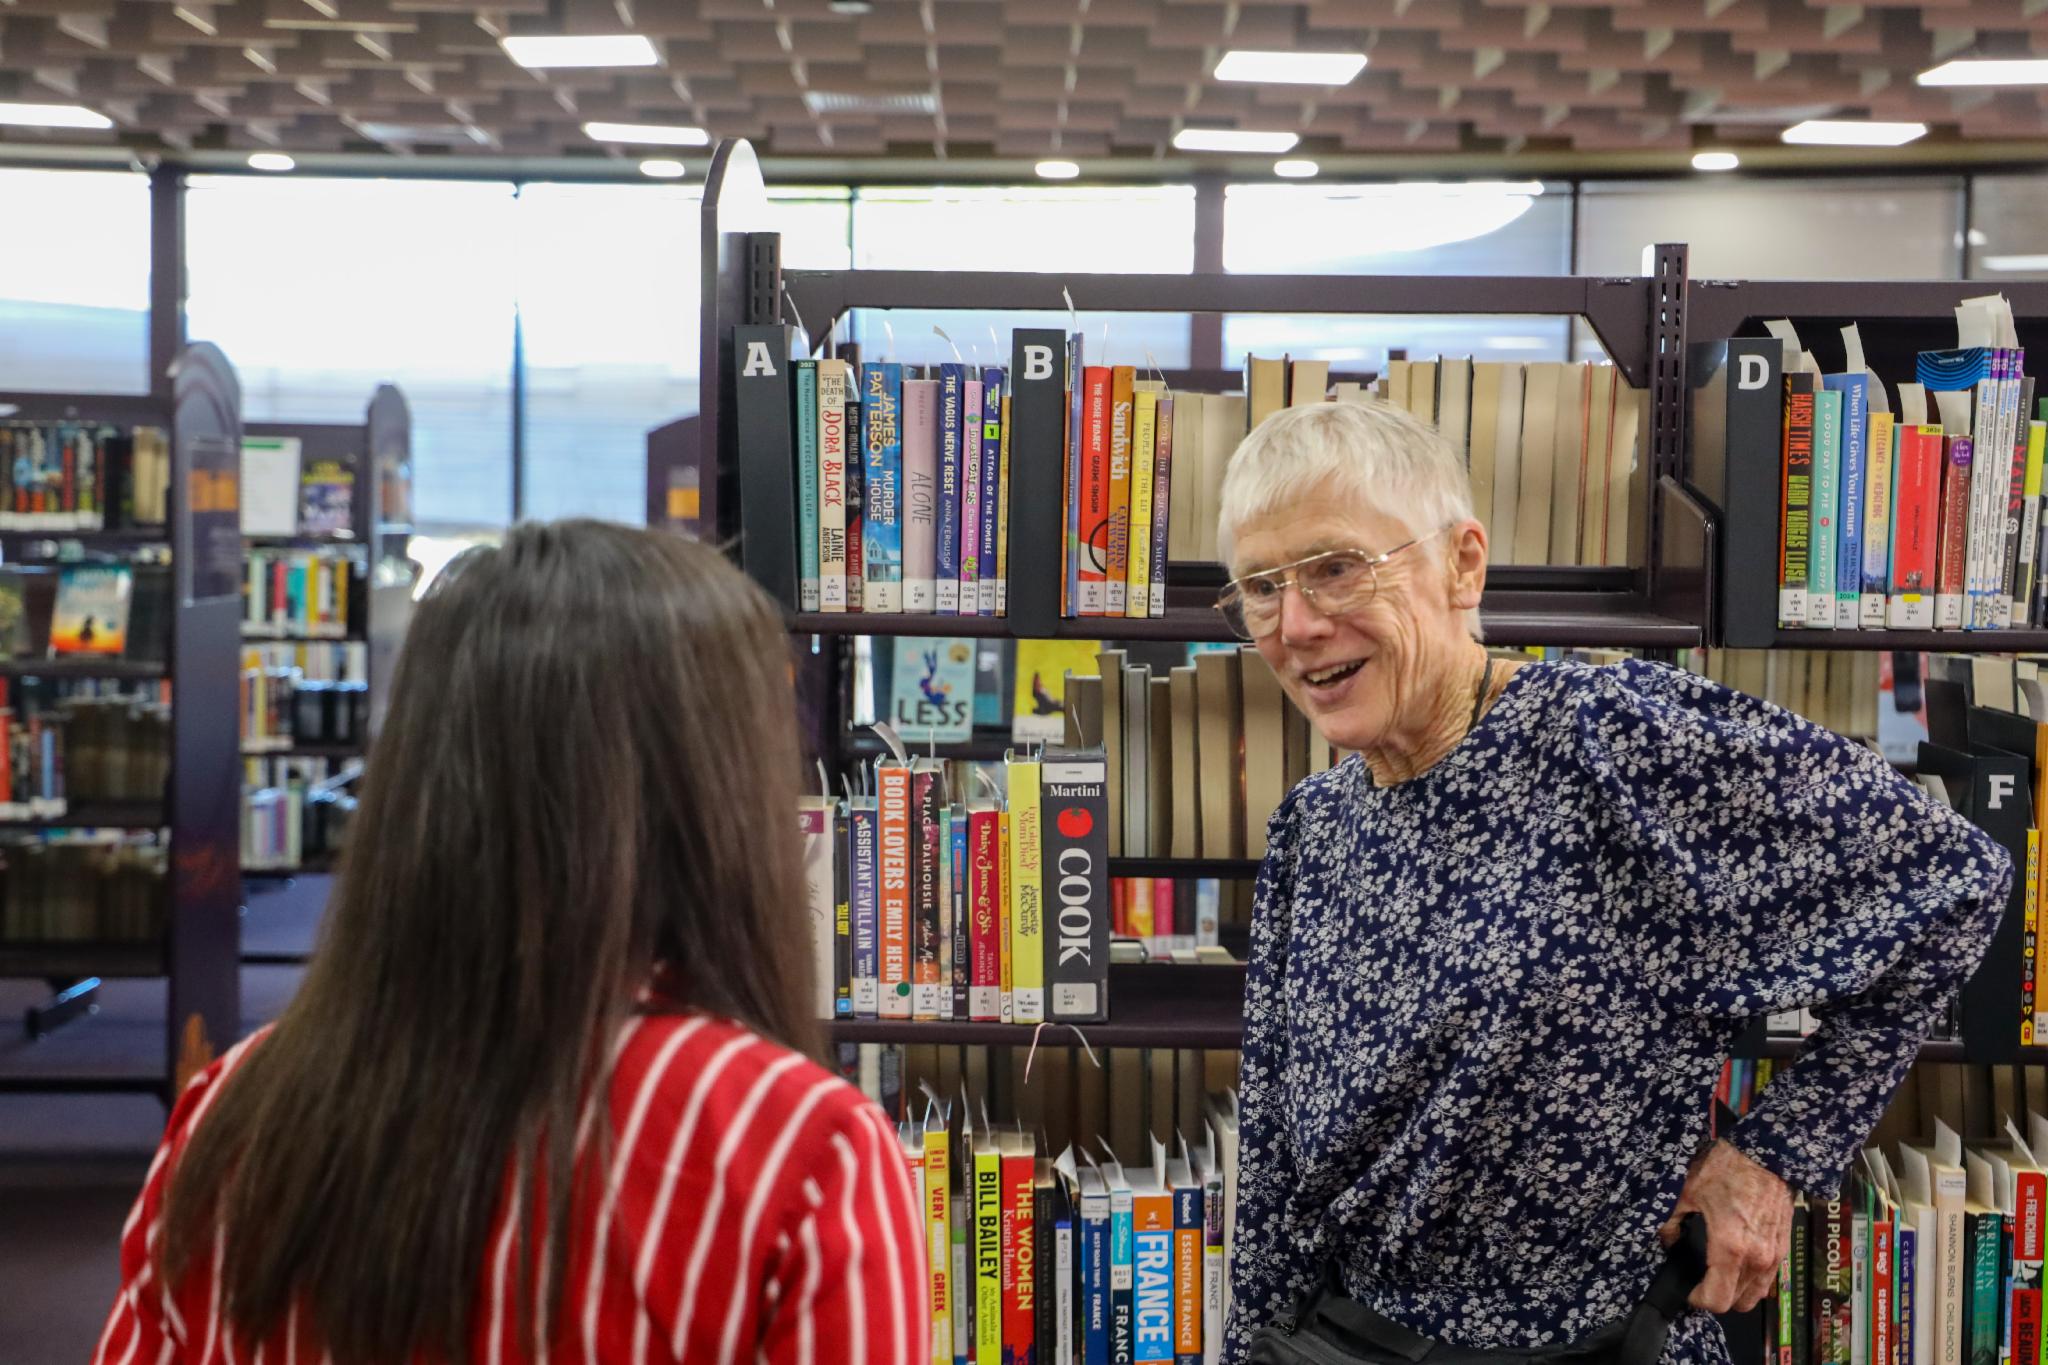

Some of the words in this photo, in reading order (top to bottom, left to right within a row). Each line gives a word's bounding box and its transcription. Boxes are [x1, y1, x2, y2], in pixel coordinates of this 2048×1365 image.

[743, 342, 777, 376] A
[1024, 345, 1053, 380] B
[1738, 354, 1770, 390] D
[821, 387, 844, 396] DEATH
[823, 377, 841, 387] THE
[945, 375, 956, 394] THE
[1094, 383, 1103, 396] THE
[827, 397, 837, 405] OF
[849, 406, 858, 425] MESSI
[945, 396, 955, 429] VAGUS
[1093, 397, 1102, 418] ROSIE
[1790, 394, 1813, 428] HARSH
[1851, 384, 1861, 416] When
[822, 410, 842, 454] DORA
[870, 371, 883, 467] PATTERSON
[884, 393, 895, 447] JAMES
[1092, 419, 1102, 452] PROJECT
[1160, 415, 1169, 446] MOORE
[1823, 413, 1831, 444] GOOD
[1850, 418, 1861, 439] Life
[849, 434, 858, 464] RONALDO
[944, 431, 955, 463] NERVE
[1112, 401, 1132, 480] Sandwich
[1143, 422, 1151, 456] PEOPLE
[1788, 430, 1812, 465] TIMES
[1849, 441, 1860, 471] Gives
[943, 465, 954, 496] RESET
[987, 449, 995, 481] ATTACK
[1822, 476, 1830, 488] TO
[2009, 445, 2026, 511] MAUS
[823, 460, 843, 507] BLACK
[871, 478, 882, 521] HOUSE
[883, 470, 895, 526] MURDER
[911, 471, 932, 526] ALONE
[987, 486, 994, 497] OF
[1787, 475, 1809, 505] MARIO
[1821, 493, 1829, 509] PIE
[1848, 473, 1859, 494] You
[944, 499, 952, 523] ANNA
[1156, 476, 1166, 528] ELOQUENCE
[1846, 496, 1858, 537] Lemurs
[1956, 492, 1965, 520] SONG
[2027, 503, 2036, 532] JAMES
[822, 527, 830, 563] ANDERSON
[1108, 512, 1117, 564] NEWMAN
[1117, 505, 1127, 571] CATHERINE
[1156, 532, 1163, 542] OF
[1786, 510, 1808, 548] VARGAS
[2024, 533, 2032, 556] ETTA
[944, 525, 952, 569] FERGUSON
[1155, 547, 1163, 582] SILENCE
[1785, 551, 1807, 582] LLOSA
[1849, 555, 1857, 590] HUSBAN
[898, 699, 968, 726] LESS
[884, 775, 906, 821] BOOK
[1050, 784, 1100, 797] Martini
[1988, 774, 2015, 809] F
[922, 796, 932, 832] PLACE
[1019, 811, 1028, 834] Mom
[857, 820, 872, 888] ASSISTANT
[979, 820, 991, 854] Daisy
[1019, 837, 1029, 867] Died
[1029, 823, 1038, 851] Glad
[884, 827, 906, 890] LOVERS
[922, 843, 932, 909] DALHOUSIE
[976, 856, 992, 895] Jones
[1028, 854, 1038, 871] My
[2027, 843, 2038, 881] ANH
[1017, 884, 1030, 937] McCurdy
[1030, 885, 1039, 935] Jennette
[1059, 848, 1092, 967] COOK
[2026, 887, 2036, 912] DO
[857, 898, 873, 949] VILLAIN
[886, 899, 903, 940] EMILY
[976, 910, 992, 936] Six
[886, 945, 903, 983] HENR
[2023, 1005, 2033, 1015] 17
[932, 1187, 944, 1220] VERY
[979, 1171, 997, 1210] BILL
[1016, 1179, 1034, 1221] THE
[1827, 1191, 1840, 1220] ODI
[2026, 1185, 2034, 1197] THE
[1182, 1193, 1191, 1224] Fodor's
[1003, 1209, 1015, 1246] Kristin
[1948, 1214, 1957, 1265] SHANNON
[2024, 1199, 2038, 1257] FRENCHMAN
[979, 1216, 998, 1280] BAILEY
[1181, 1234, 1192, 1295] ESSENTIAL
[1796, 1226, 1805, 1271] COLLEEN
[1827, 1224, 1841, 1292] PICOULT
[1975, 1219, 1987, 1290] HANNAH
[1985, 1220, 1996, 1289] KRISTIN
[1003, 1248, 1015, 1291] Hannah
[1016, 1225, 1034, 1310] WOMEN
[1093, 1269, 1101, 1288] TRIPS
[1947, 1266, 1956, 1297] BURNS
[933, 1273, 946, 1312] GREEK
[981, 1286, 989, 1309] Other
[1137, 1234, 1169, 1342] FRANCE
[1209, 1271, 1218, 1310] FRANCE
[981, 1311, 989, 1346] Animals
[989, 1298, 997, 1331] Animals
[1092, 1293, 1101, 1330] FRANCE
[1181, 1299, 1192, 1347] FRANCE
[1115, 1305, 1128, 1365] FRANC
[1945, 1303, 1955, 1362] CHILDHOOD
